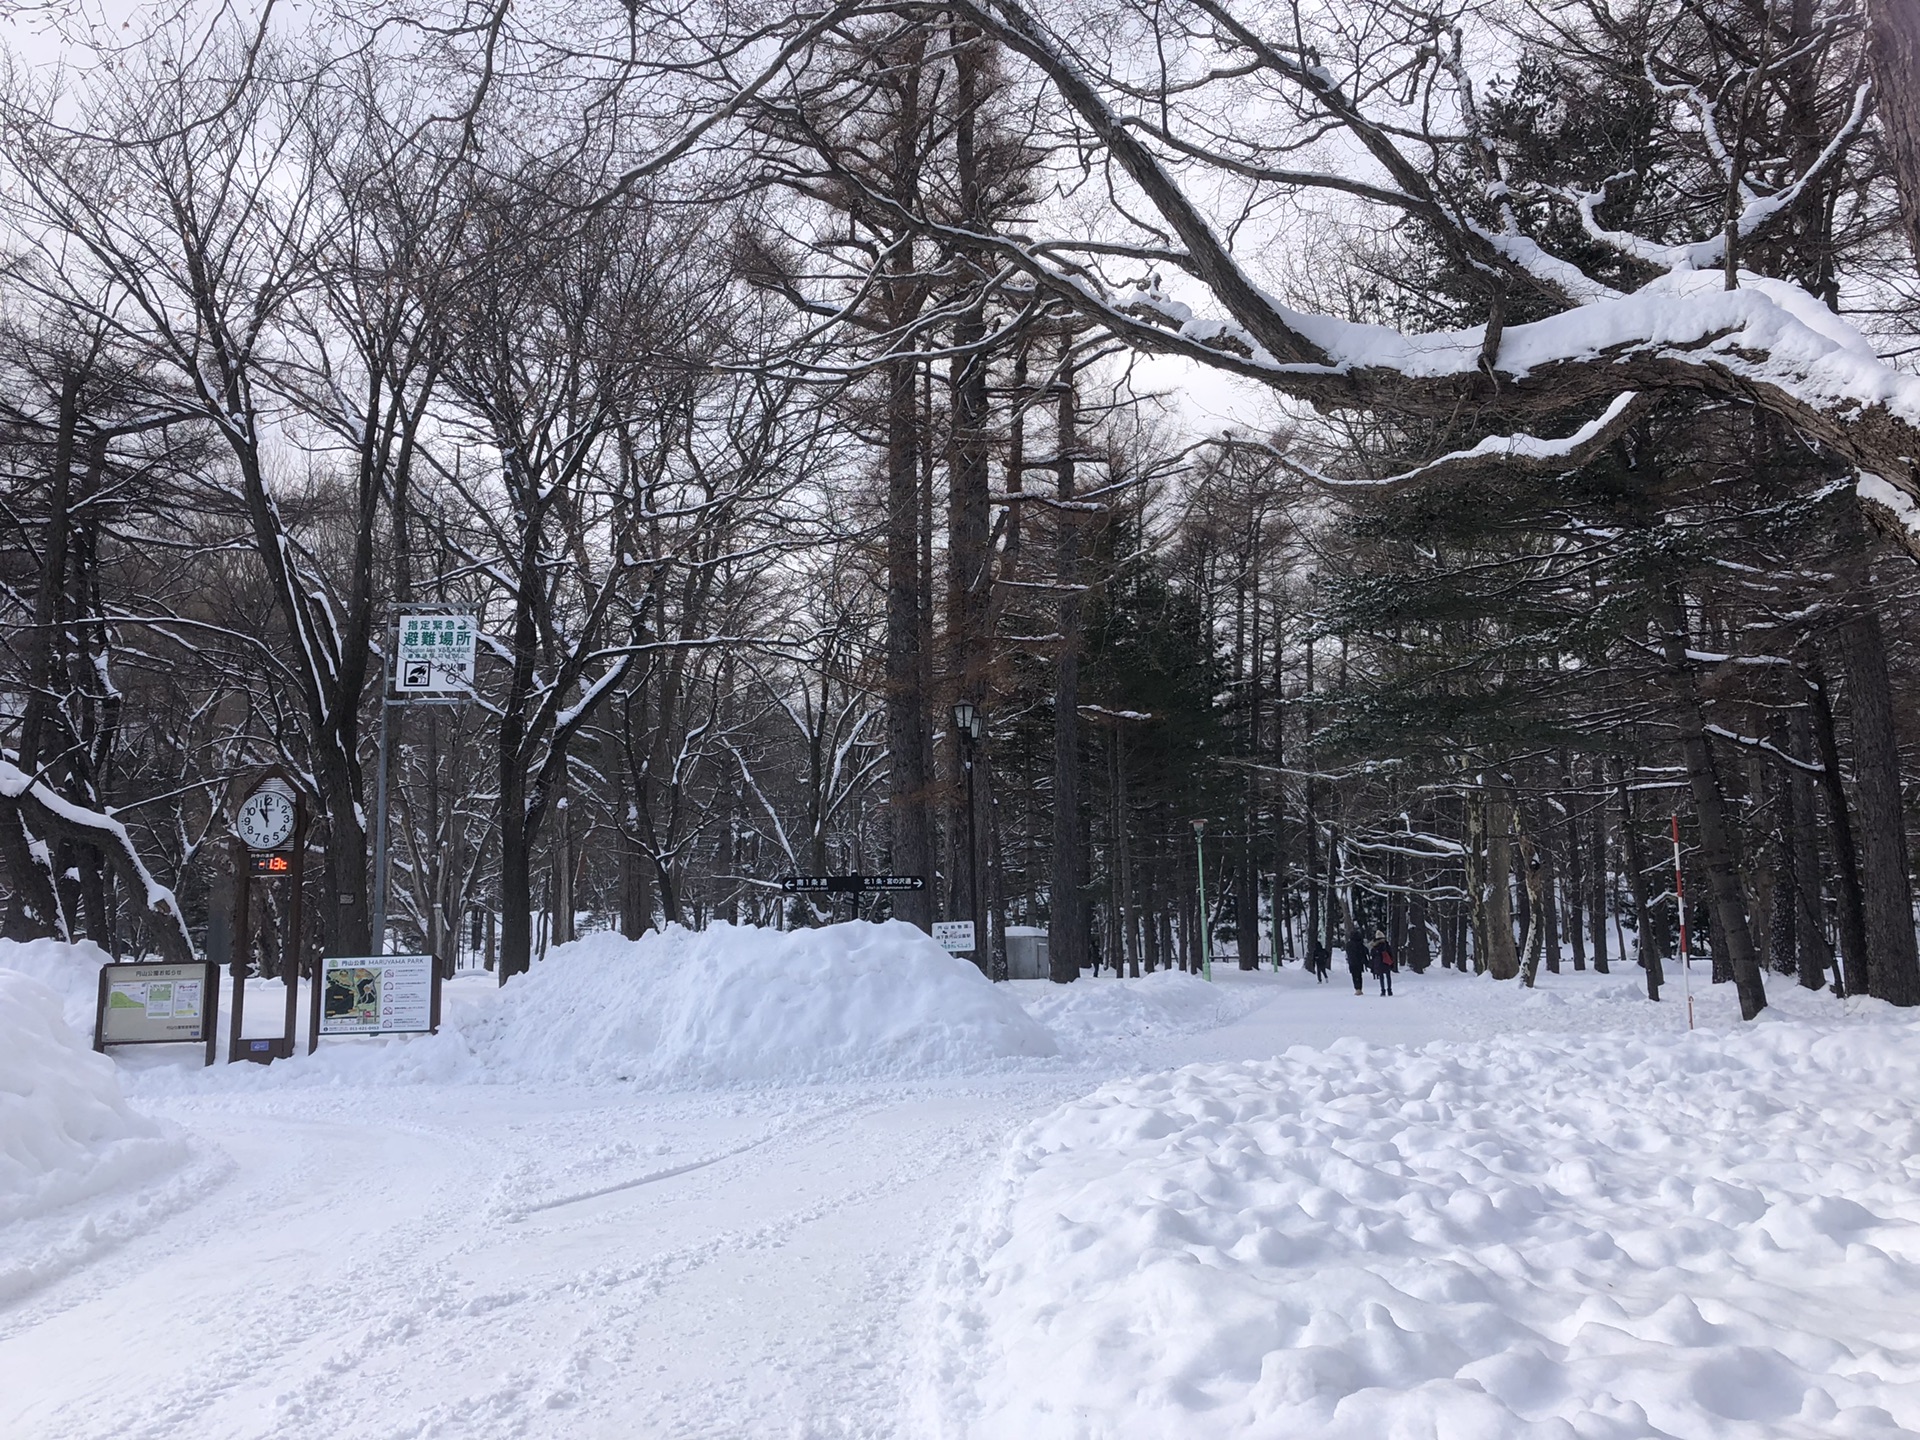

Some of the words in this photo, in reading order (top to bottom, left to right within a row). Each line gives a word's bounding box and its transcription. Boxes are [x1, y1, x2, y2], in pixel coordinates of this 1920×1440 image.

[408, 620, 455, 630] 指定緊急
[403, 631, 471, 646] 避難場所
[255, 798, 263, 808] 11
[245, 807, 256, 816] 10
[281, 805, 288, 814] 2
[244, 817, 251, 826] 9
[283, 815, 290, 823] 3
[247, 825, 254, 834] 8
[254, 833, 261, 841] 7
[263, 835, 270, 843] 6
[272, 832, 279, 840] 5
[135, 969, 182, 977] 円山公園お知らせ
